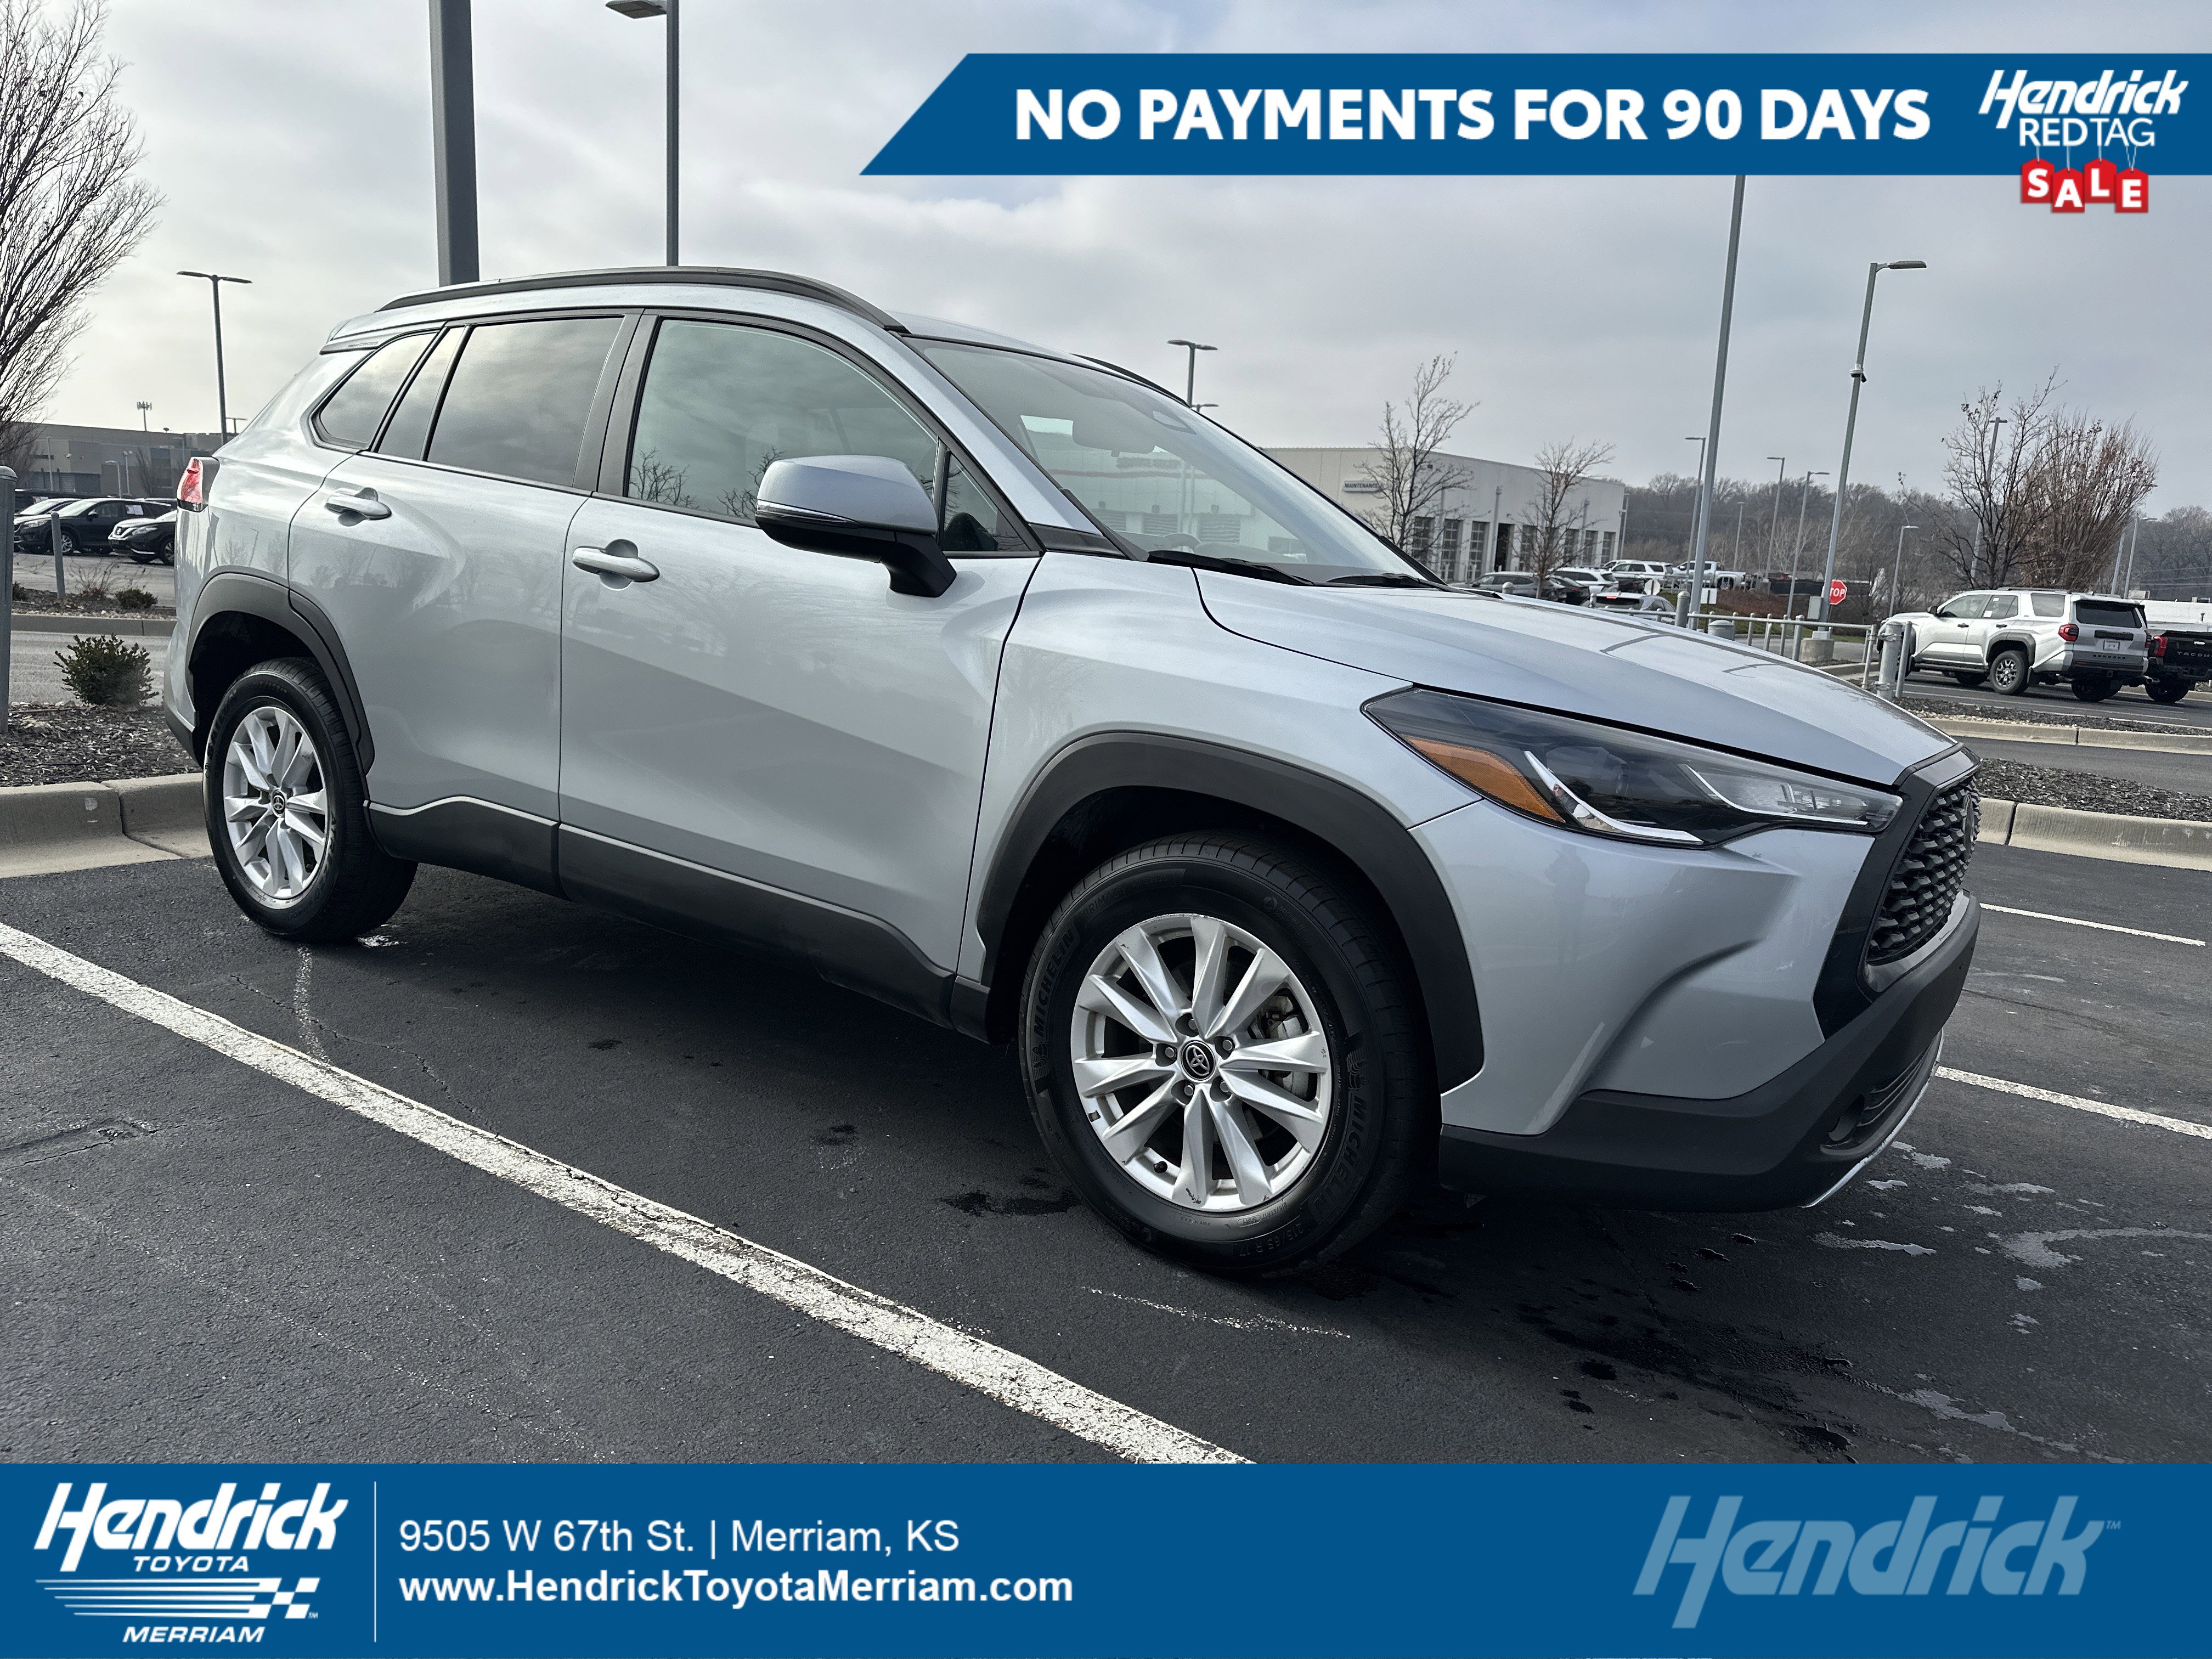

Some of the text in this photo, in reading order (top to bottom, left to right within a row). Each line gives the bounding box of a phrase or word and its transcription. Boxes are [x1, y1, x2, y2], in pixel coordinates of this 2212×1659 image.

[1830, 588, 1846, 597] TOP
[1033, 927, 1076, 1037] MICHELIN
[1313, 1096, 1368, 1216] MICHELIN
